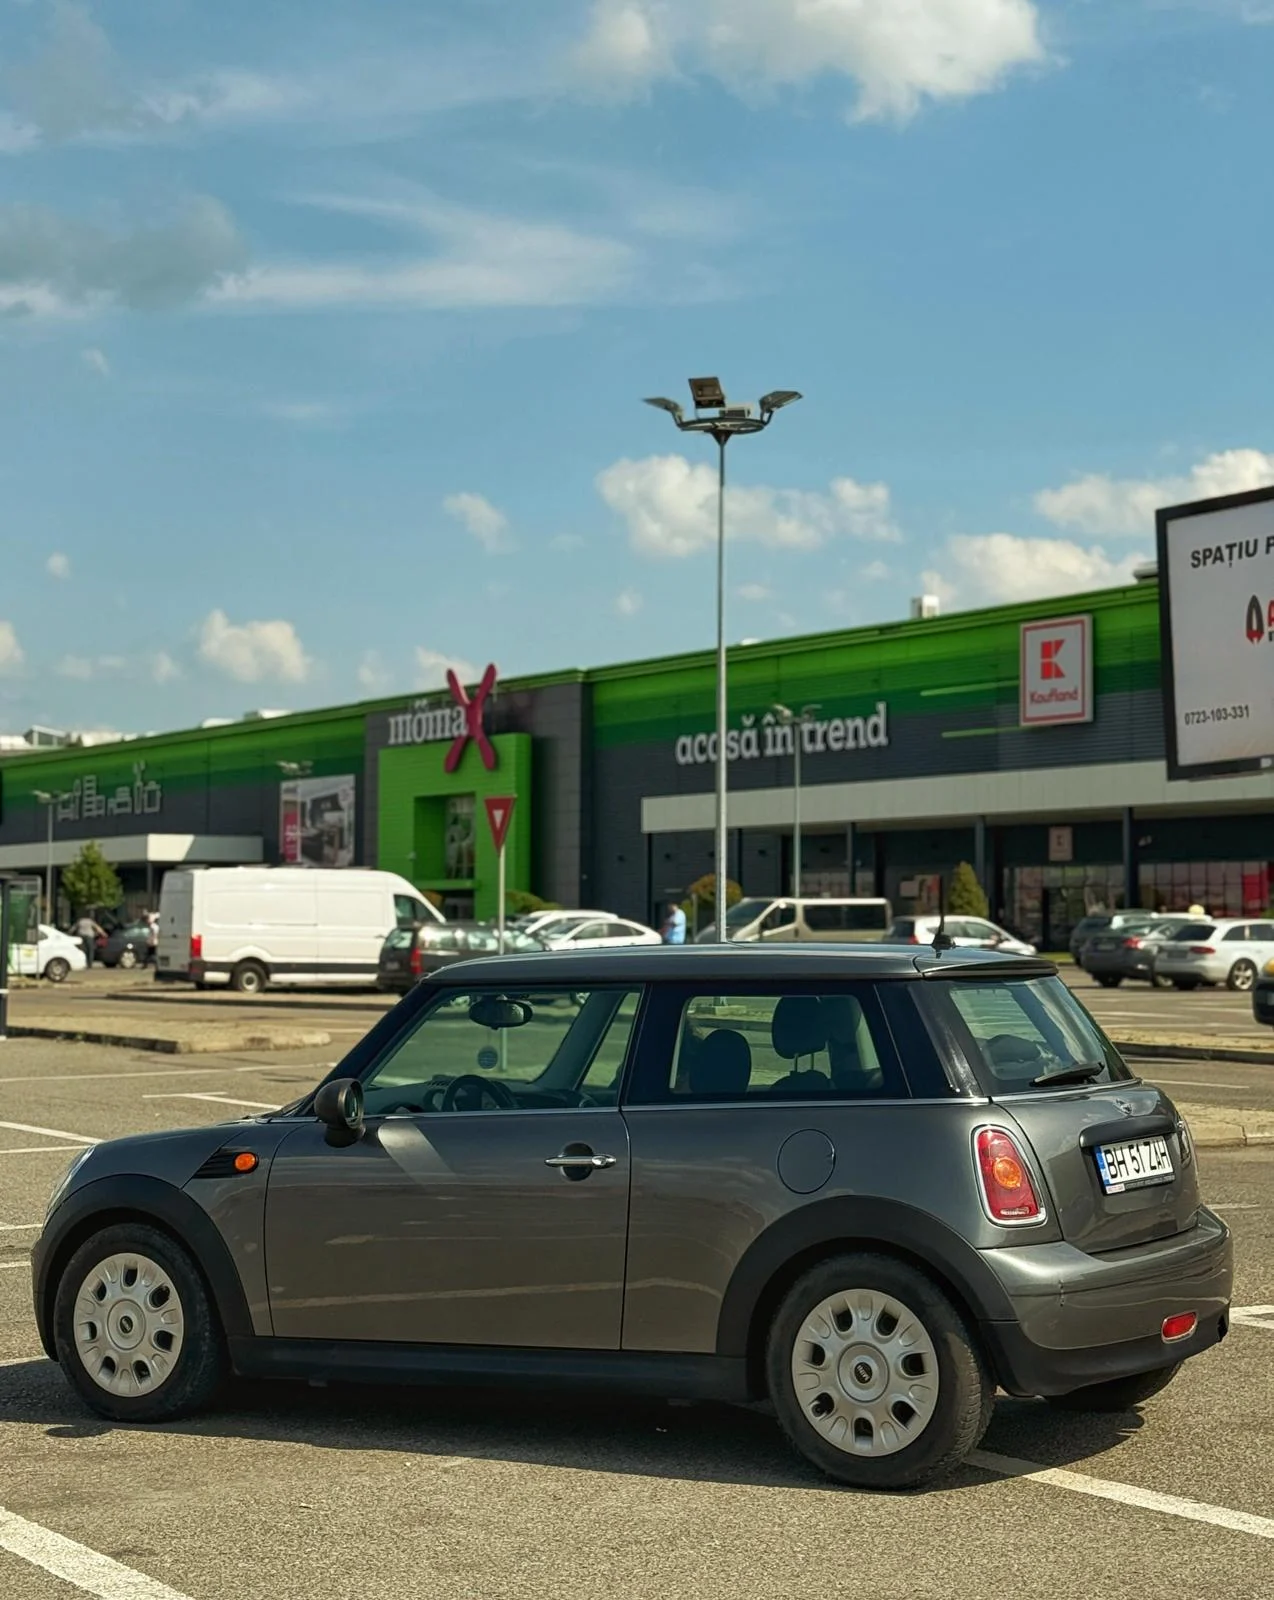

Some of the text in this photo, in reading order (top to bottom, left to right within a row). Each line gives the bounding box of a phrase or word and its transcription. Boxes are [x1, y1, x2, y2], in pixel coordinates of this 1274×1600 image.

[1191, 538, 1258, 568] SPAȚIU
[1041, 639, 1066, 681] K
[762, 712, 793, 755] în
[800, 702, 888, 751] trend
[1184, 704, 1250, 726] 0723-103-331
[1104, 1140, 1170, 1178] BH 51 ZAH
